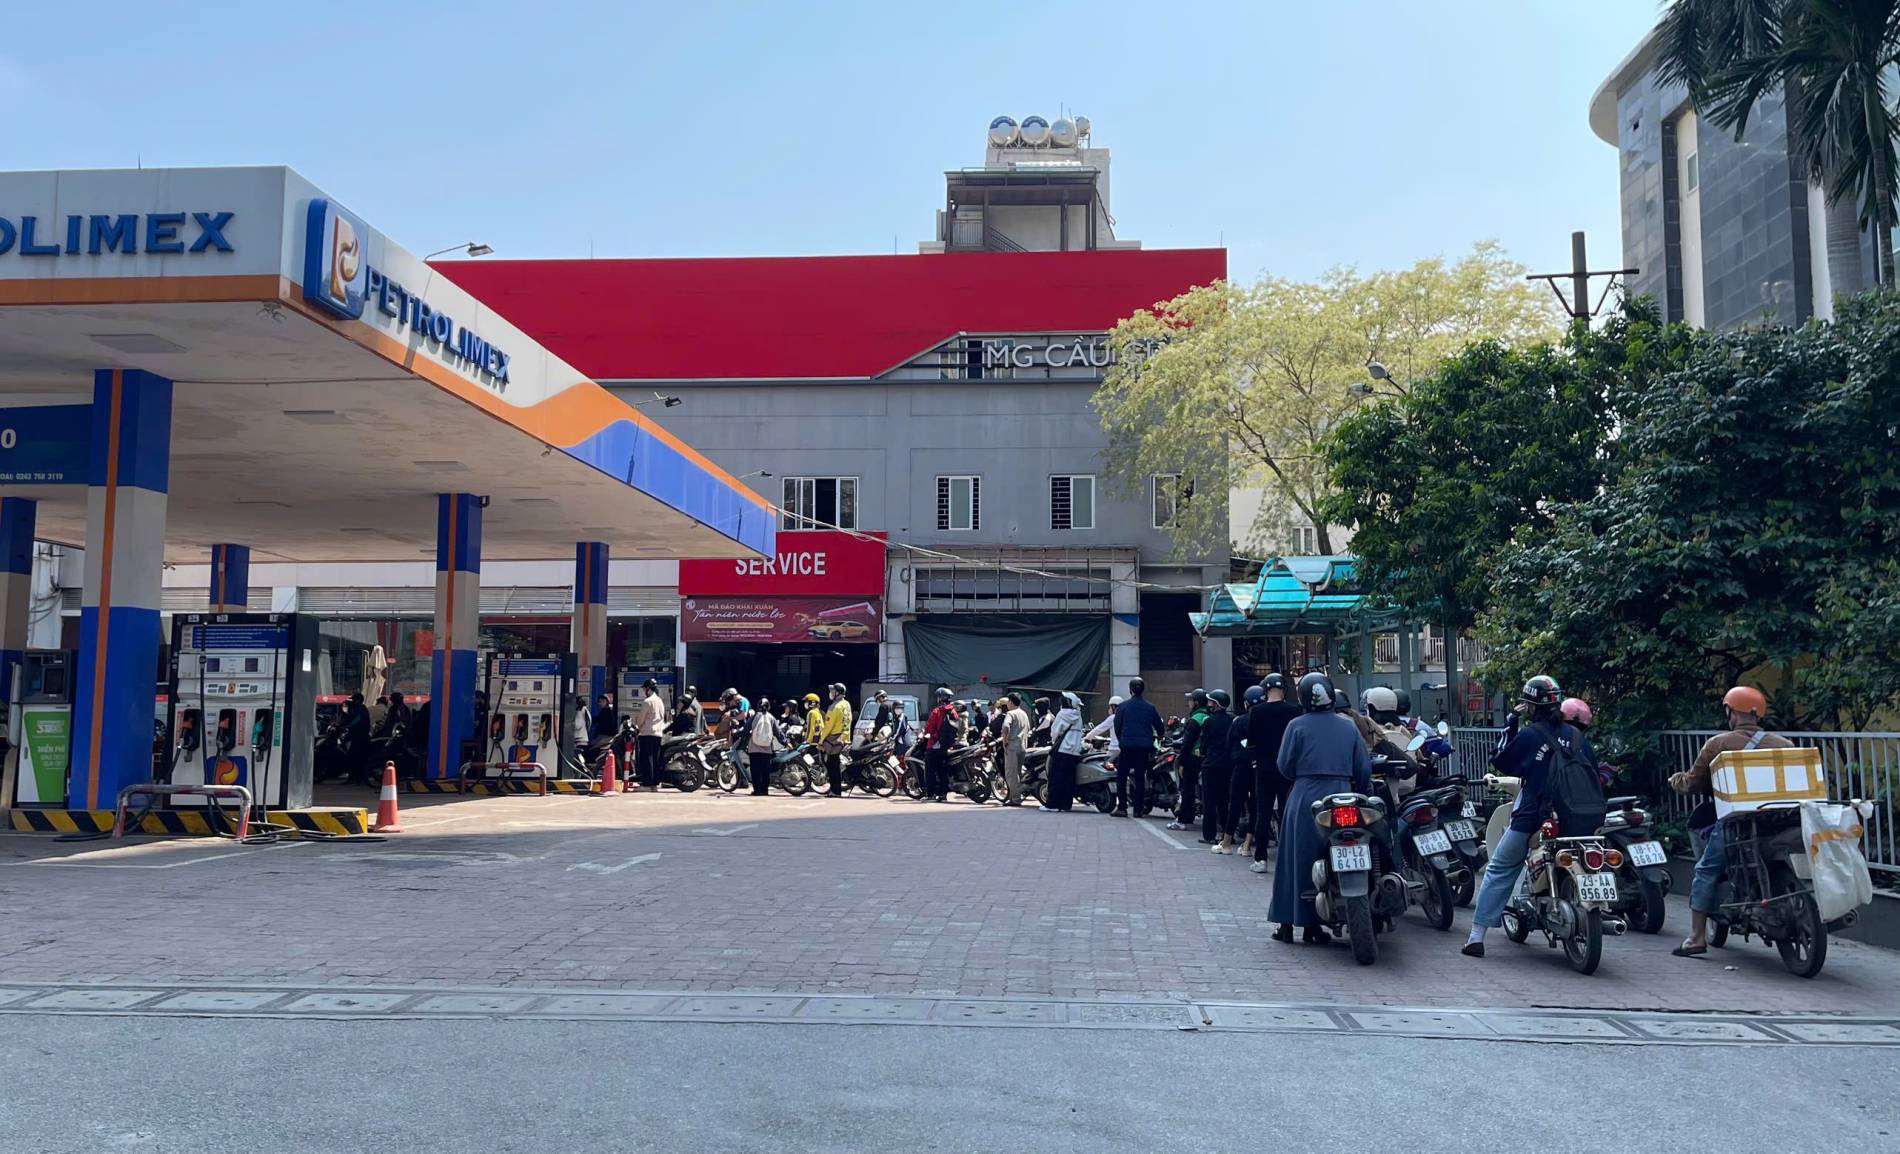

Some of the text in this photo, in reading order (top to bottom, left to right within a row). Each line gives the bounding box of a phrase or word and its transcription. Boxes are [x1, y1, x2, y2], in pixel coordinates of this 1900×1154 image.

[365, 265, 511, 384] PETROLIMEX
[987, 344, 1033, 368] MG
[735, 552, 826, 575] SERVICE
[1338, 858, 1366, 870] 6410
[1582, 875, 1611, 887] 29-AA
[1580, 887, 1616, 900] 956.89
